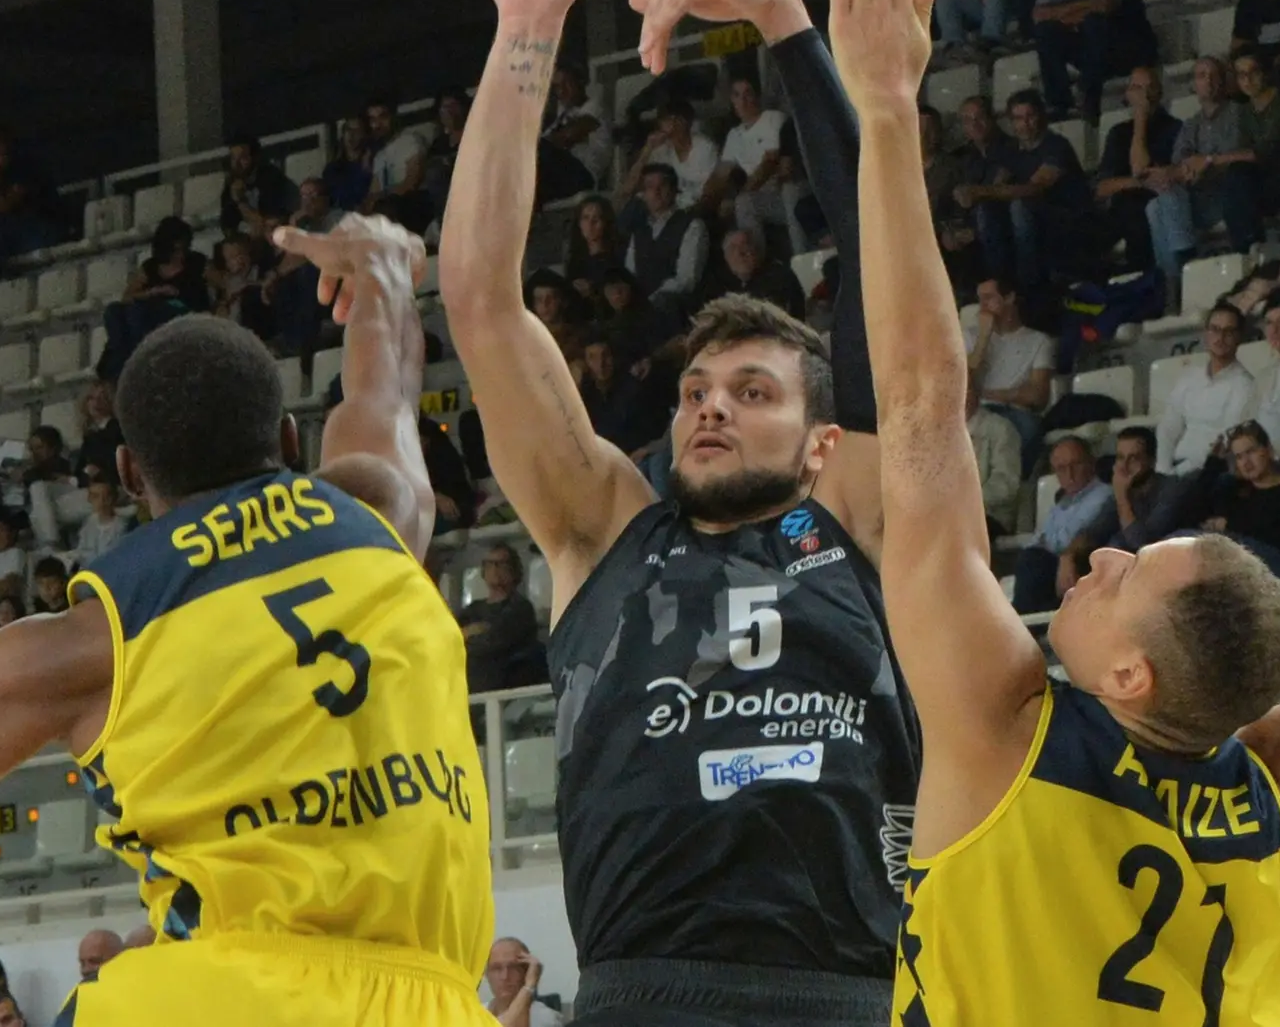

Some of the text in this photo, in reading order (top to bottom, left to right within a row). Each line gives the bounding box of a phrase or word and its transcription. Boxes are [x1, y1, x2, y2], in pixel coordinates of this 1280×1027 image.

[171, 477, 336, 568] SEARS
[262, 577, 373, 718] 5
[728, 584, 783, 672] 5
[704, 687, 868, 726] Dolomiti
[760, 714, 864, 746] energia
[1097, 843, 1235, 1027] 21
